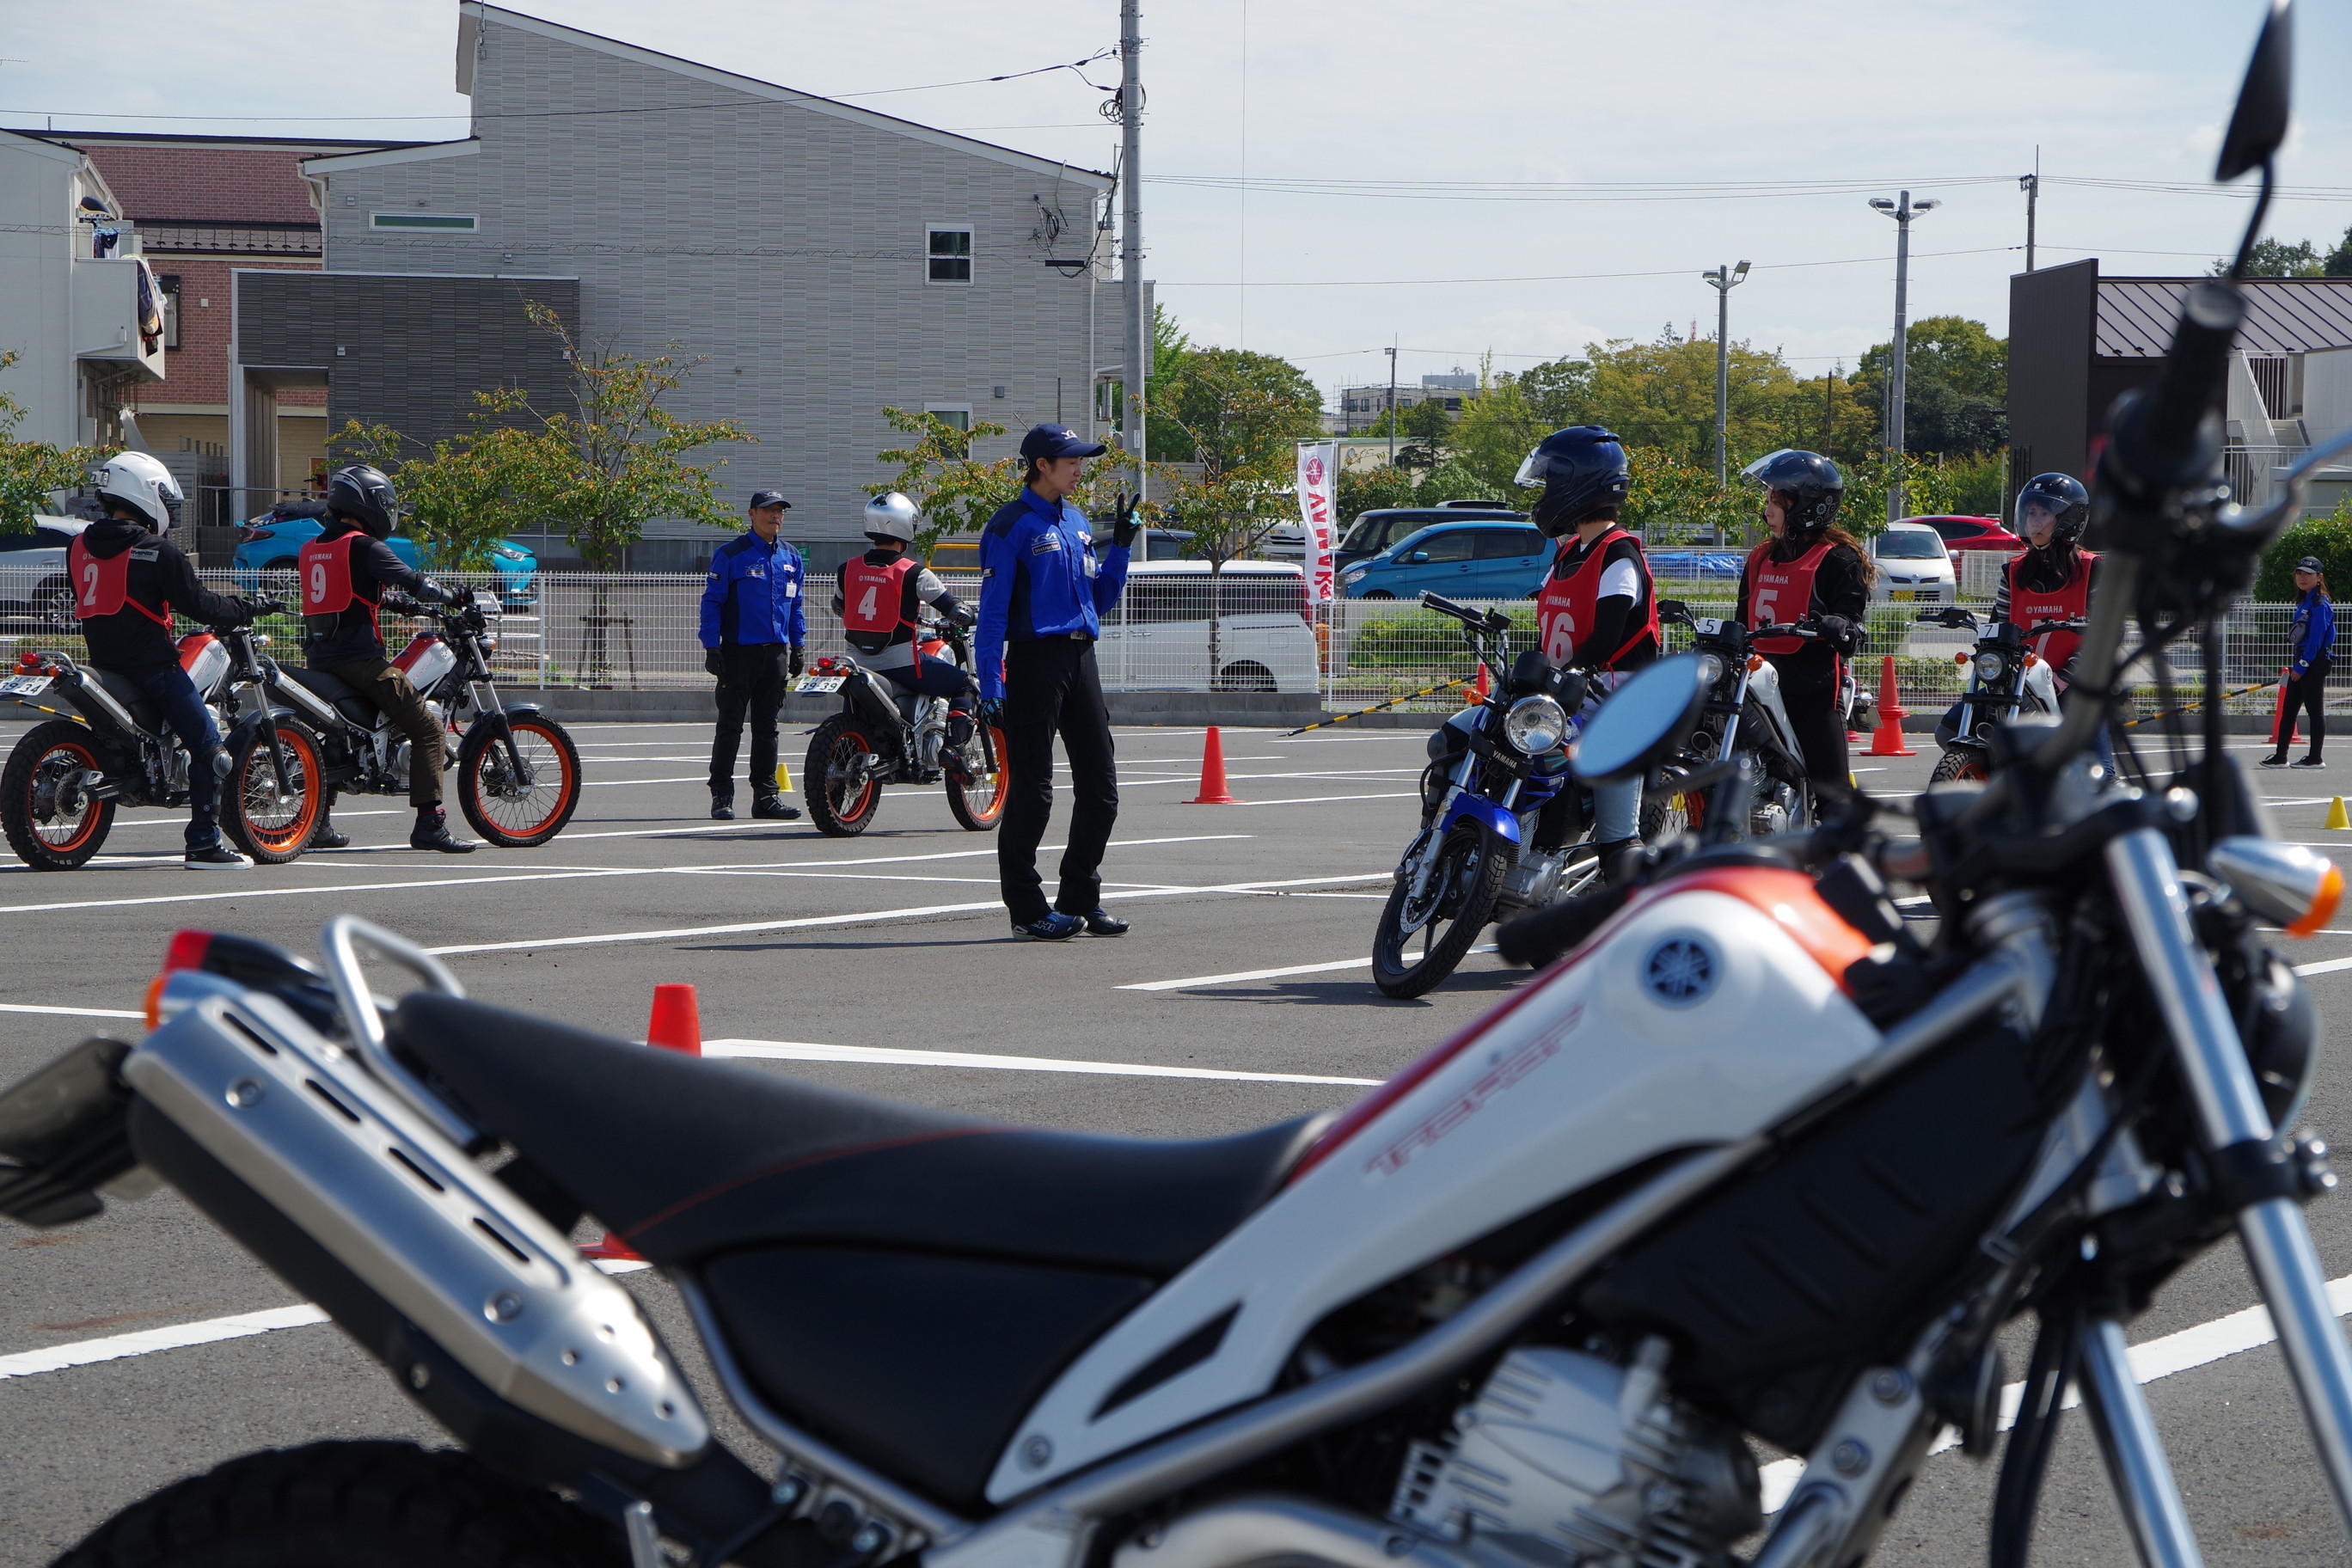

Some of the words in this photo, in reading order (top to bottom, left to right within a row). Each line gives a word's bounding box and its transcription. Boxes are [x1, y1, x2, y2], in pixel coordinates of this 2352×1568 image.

[83, 563, 99, 606] 2
[310, 563, 327, 603] 9
[863, 575, 886, 584] YAMAHA
[1761, 574, 1789, 585] YAMAHA
[857, 585, 878, 621] 4
[1548, 596, 1571, 608] YAMAHA
[1755, 588, 1779, 630] 5
[2033, 605, 2063, 614] YAMAHA
[1704, 619, 1716, 634] 5
[1984, 624, 1994, 638] 7
[1540, 611, 1575, 669] 16
[1492, 750, 1518, 769] YAMAHA
